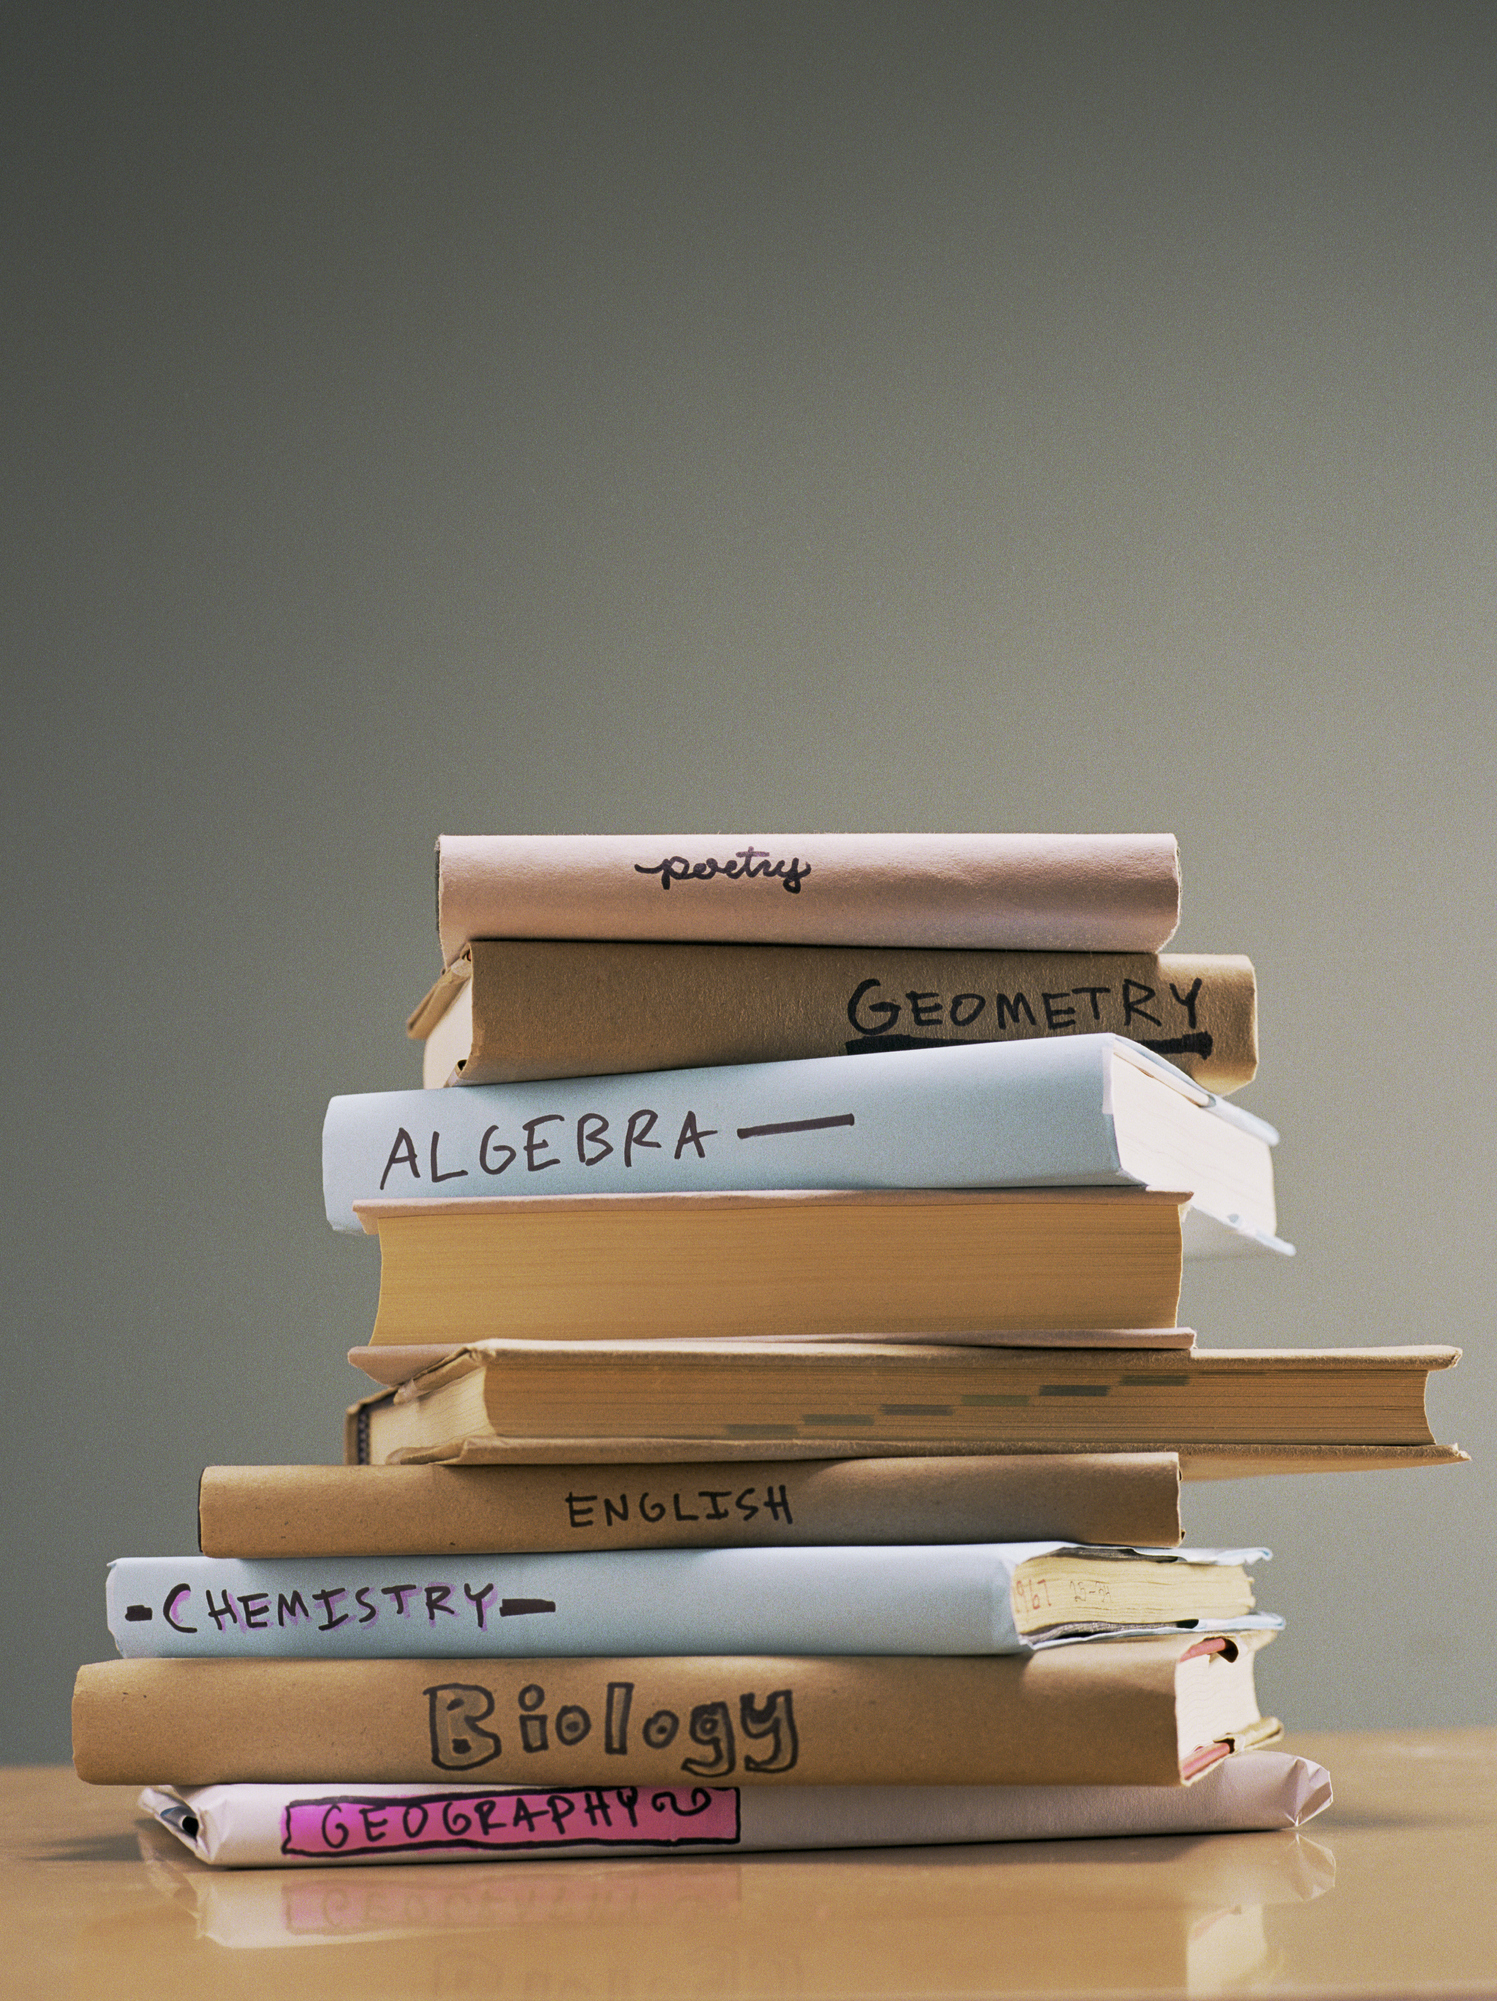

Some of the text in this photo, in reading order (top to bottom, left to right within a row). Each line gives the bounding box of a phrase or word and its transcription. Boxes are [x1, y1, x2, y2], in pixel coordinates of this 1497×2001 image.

[635, 847, 811, 893] poetry
[847, 978, 1204, 1035] GEOMETRY
[380, 1110, 718, 1191] ALGEBRA
[566, 1485, 793, 1527] ENGLISH
[423, 1683, 798, 1776] Biology
[321, 1789, 640, 1849] GEOGRAPHY
